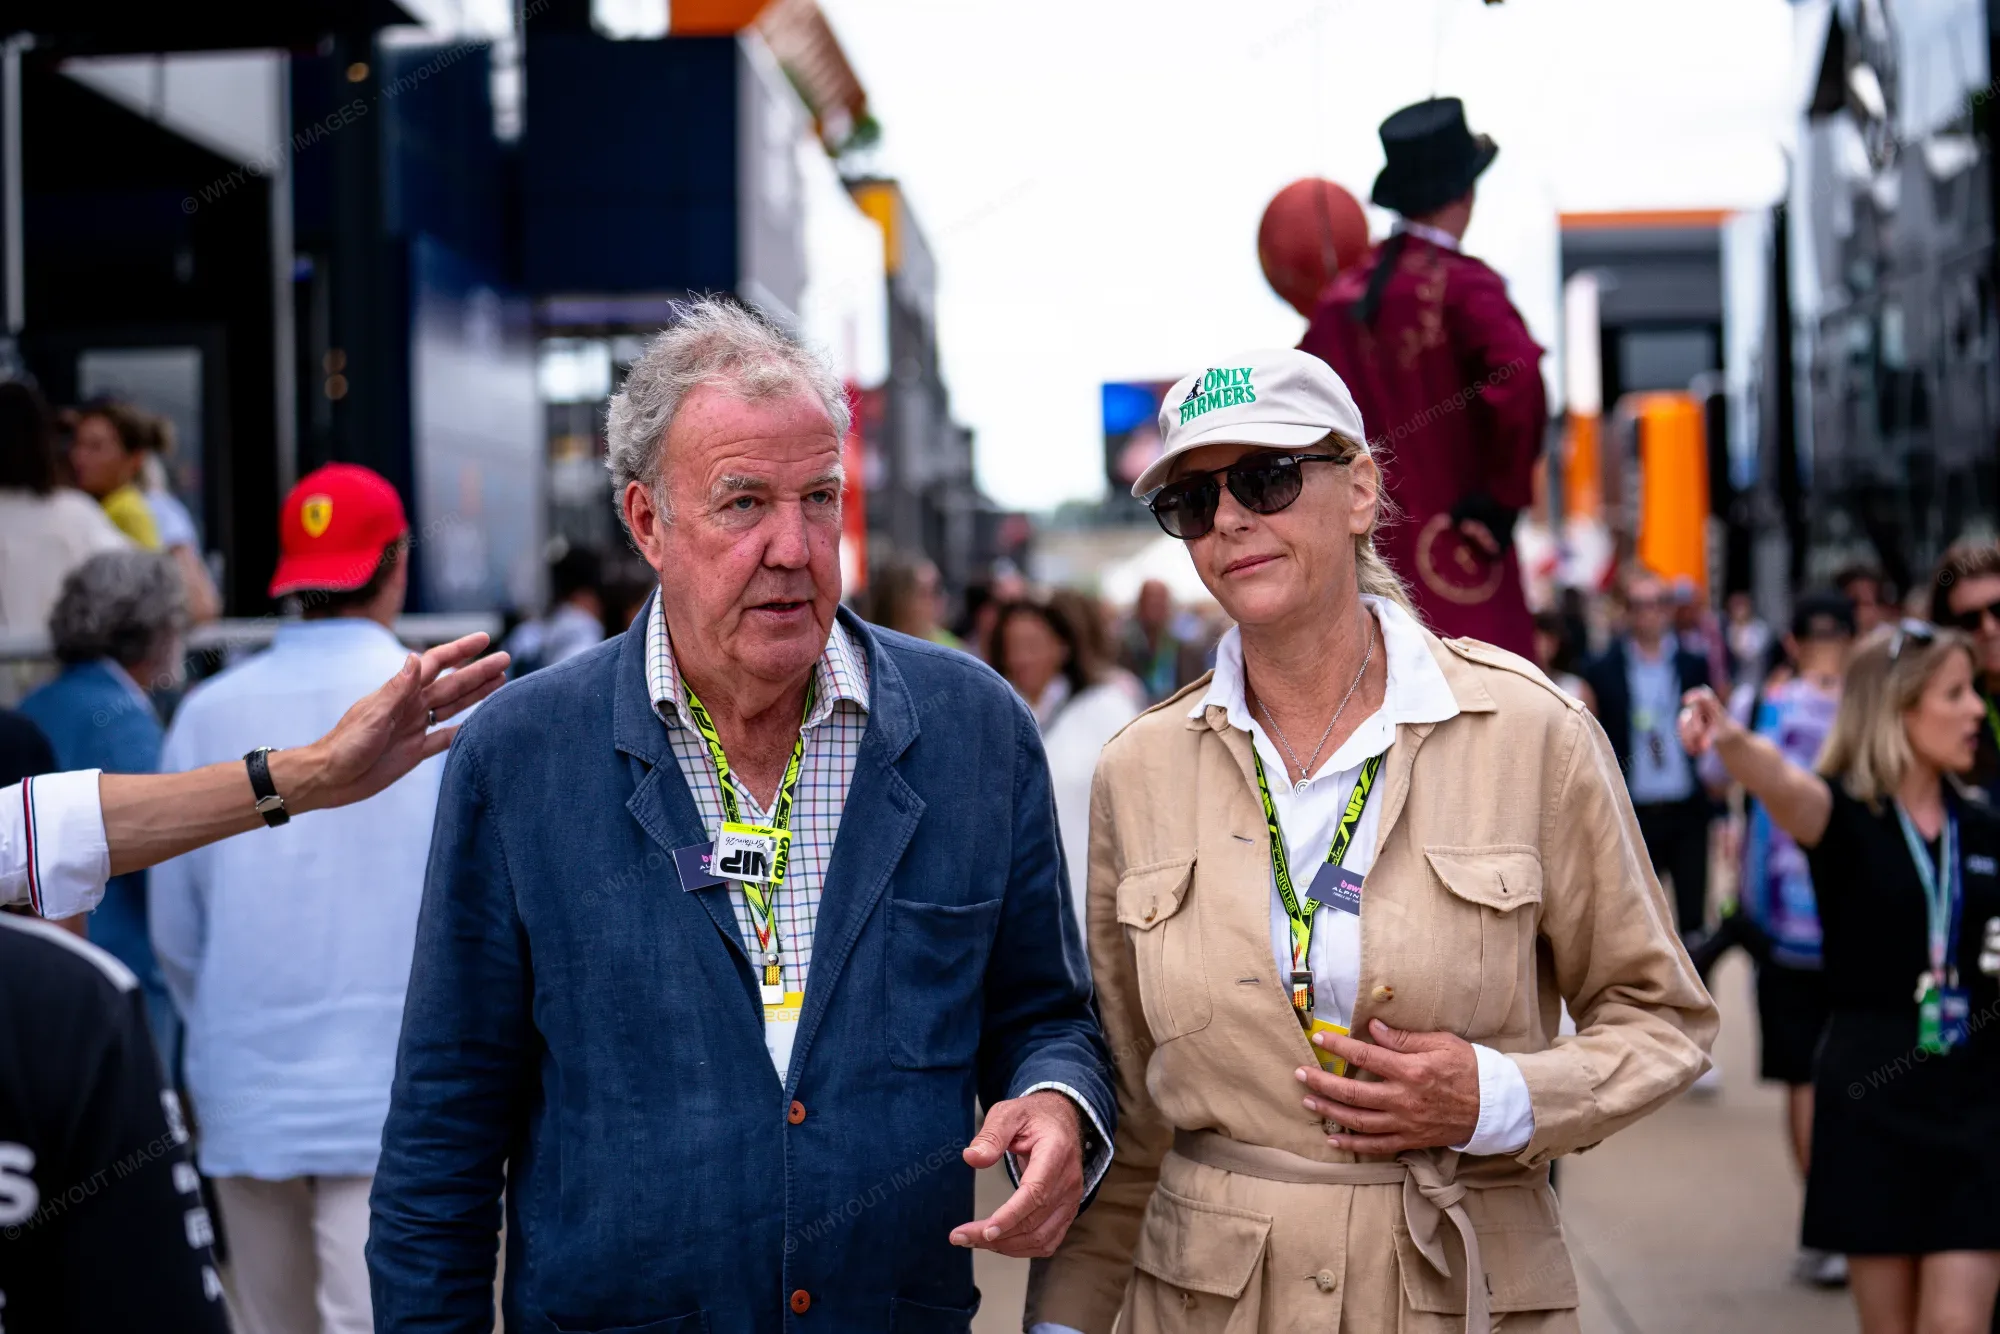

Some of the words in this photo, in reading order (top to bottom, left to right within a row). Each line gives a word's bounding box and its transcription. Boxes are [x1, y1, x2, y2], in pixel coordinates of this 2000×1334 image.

[1204, 367, 1254, 391] ONLY
[1179, 384, 1257, 426] FARMERS
[1343, 786, 1365, 823] VIP
[720, 849, 770, 877] VIP
[774, 837, 790, 879] GRID
[1278, 872, 1296, 913] BRITAIN
[1332, 886, 1360, 898] ALPIN
